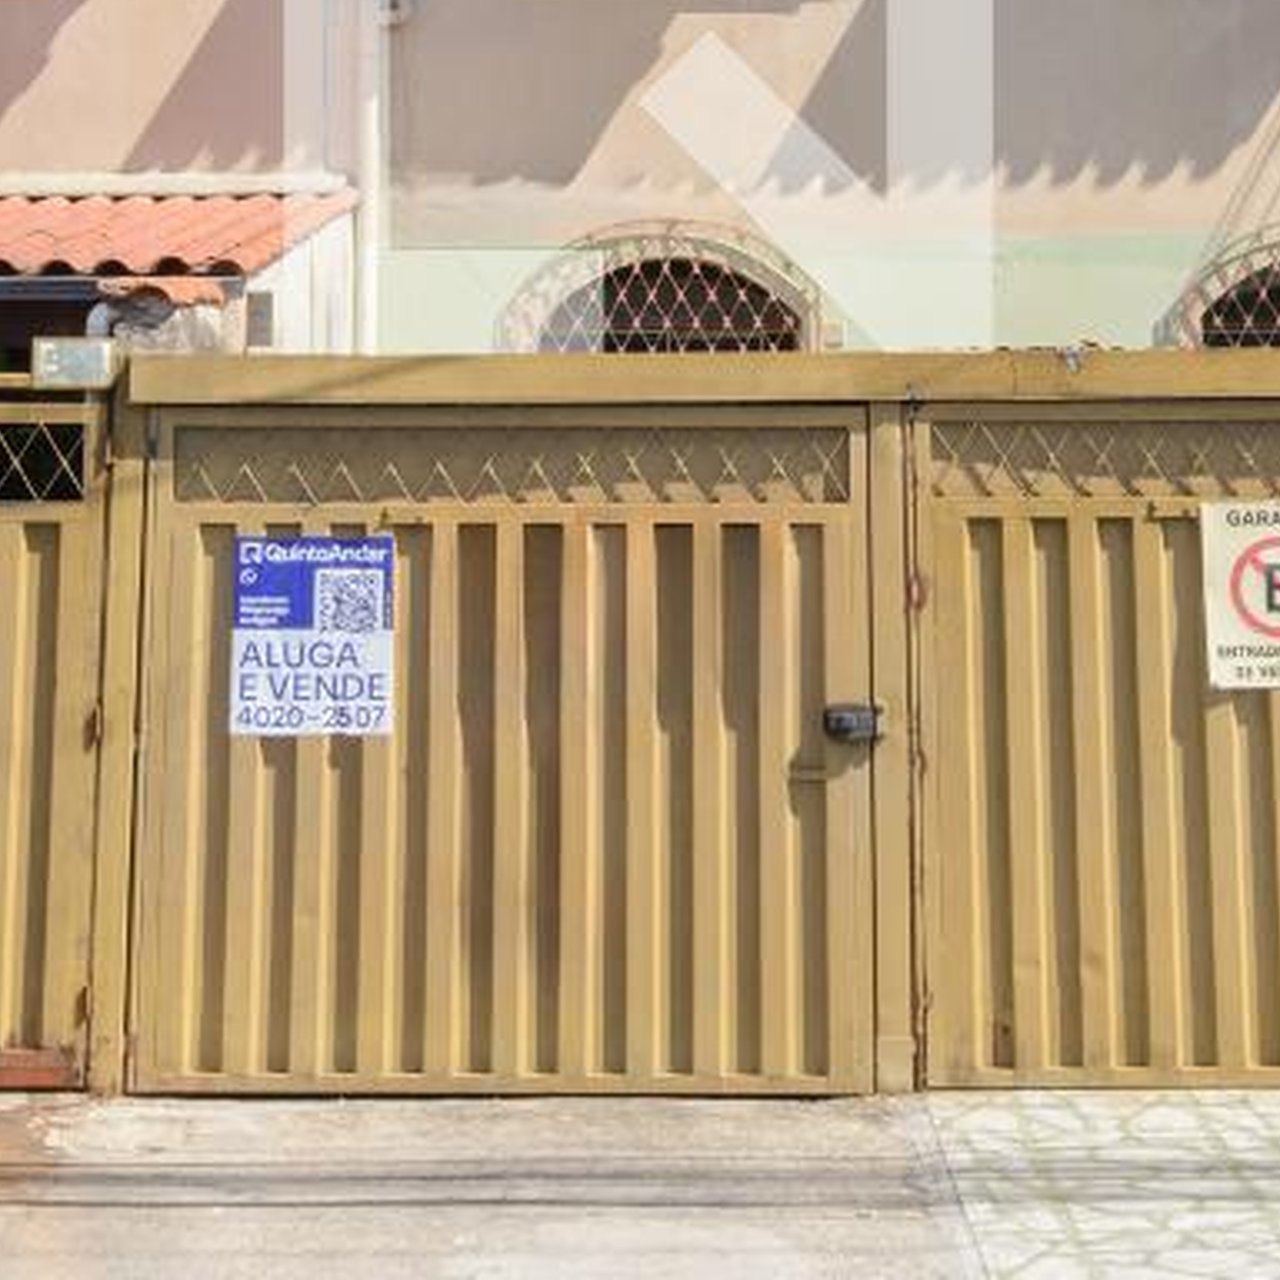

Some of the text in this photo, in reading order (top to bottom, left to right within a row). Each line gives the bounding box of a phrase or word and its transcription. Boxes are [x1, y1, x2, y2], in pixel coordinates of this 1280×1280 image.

[265, 542, 389, 562] QuintoAndar
[238, 641, 360, 668] ALUGA
[238, 673, 387, 701] E VENDE
[236, 706, 386, 729] 4020-2507
